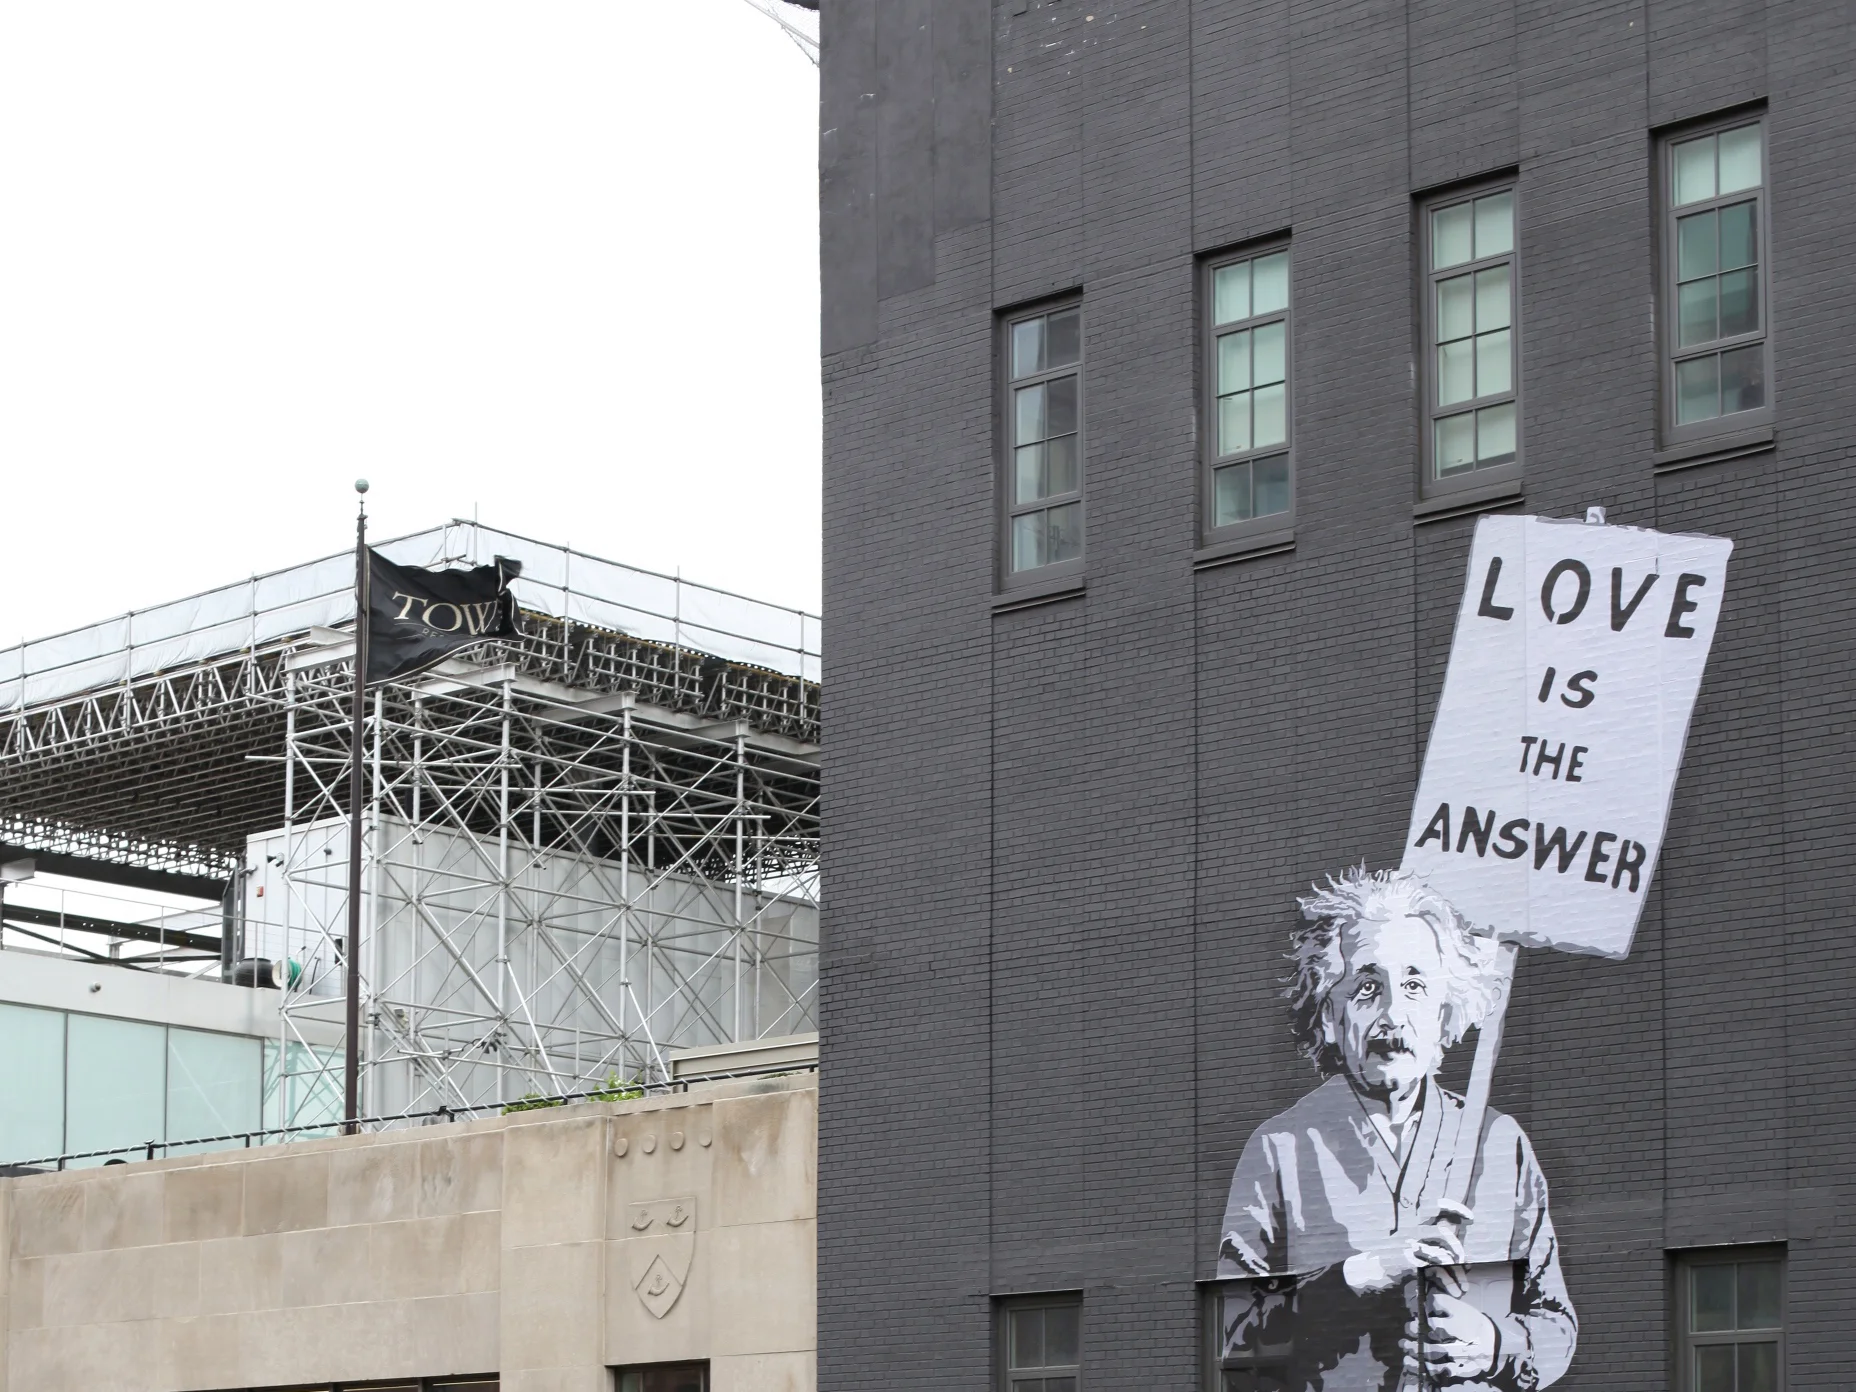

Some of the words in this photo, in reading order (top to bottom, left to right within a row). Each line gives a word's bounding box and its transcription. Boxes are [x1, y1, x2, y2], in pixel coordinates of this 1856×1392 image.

[392, 591, 502, 636] TOW
[1477, 556, 1706, 639] LOVE
[1537, 667, 1598, 708] IS
[1519, 736, 1589, 782] THE
[1414, 803, 1647, 893] ANSWER
